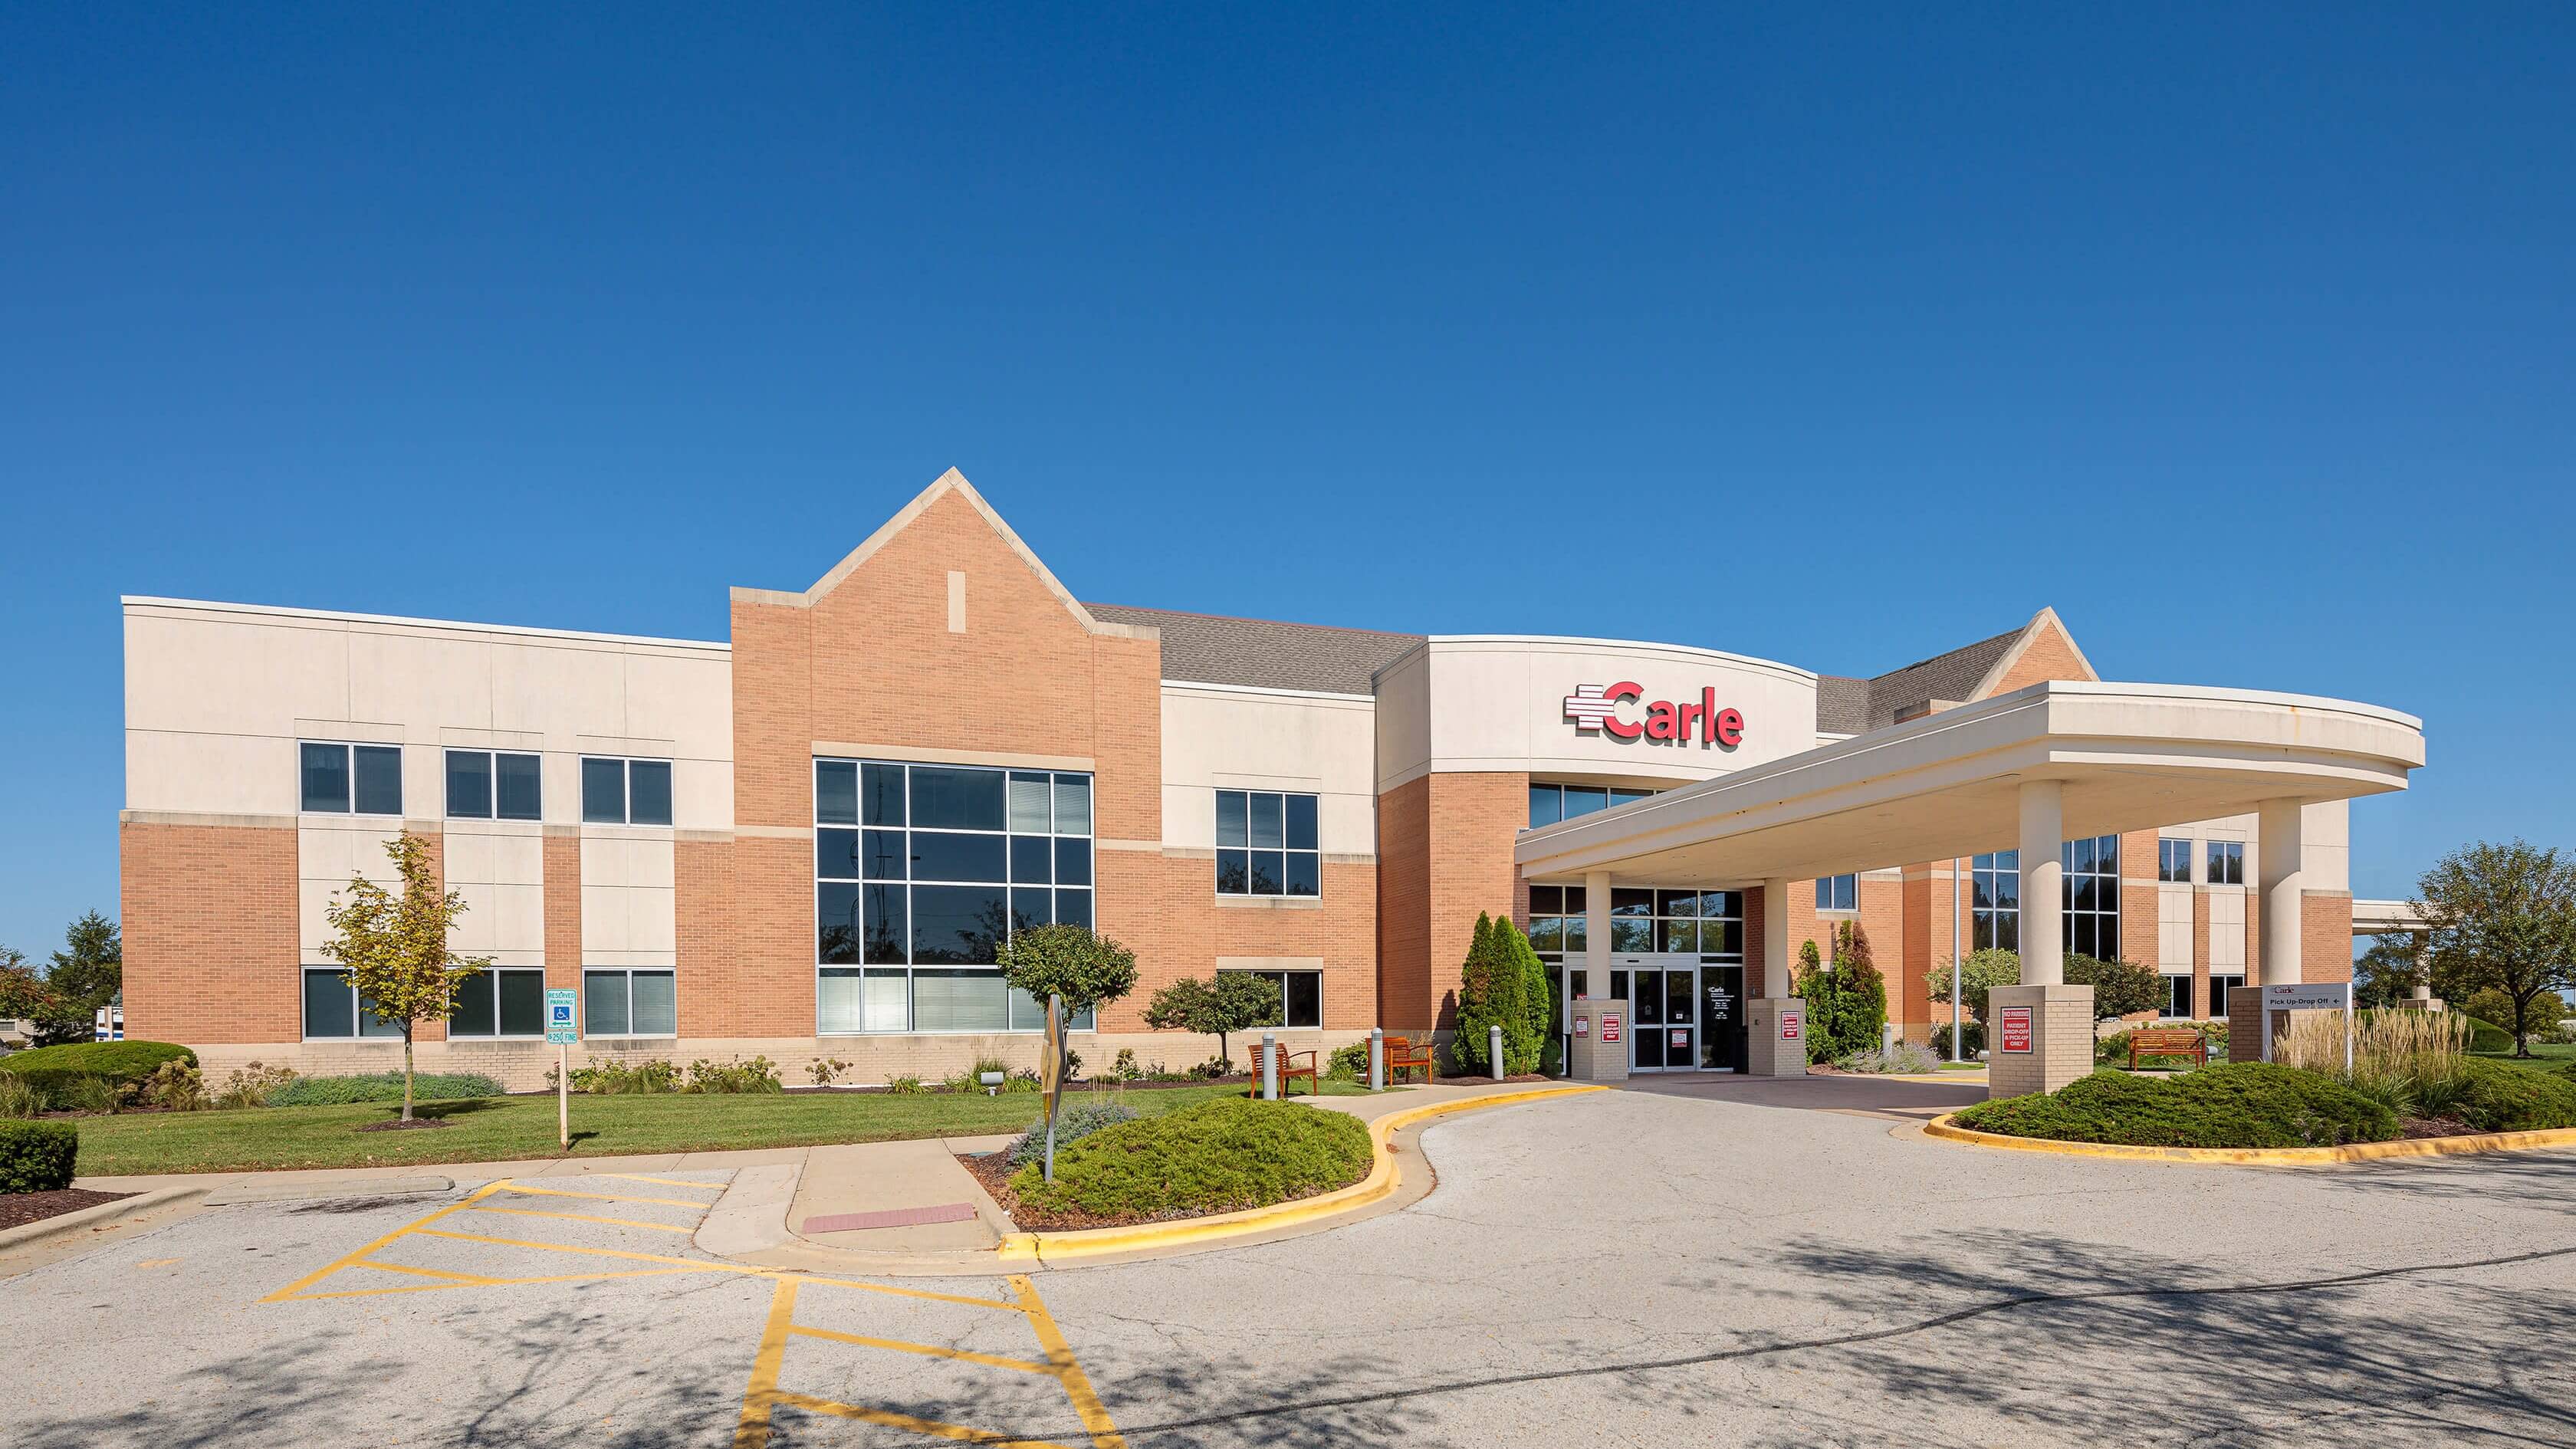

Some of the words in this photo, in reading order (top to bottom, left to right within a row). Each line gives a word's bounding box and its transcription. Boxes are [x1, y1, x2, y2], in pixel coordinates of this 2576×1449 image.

[1602, 681, 1744, 746] Carle
[547, 1033, 564, 1042] $250
[565, 1033, 577, 1041] FINE
